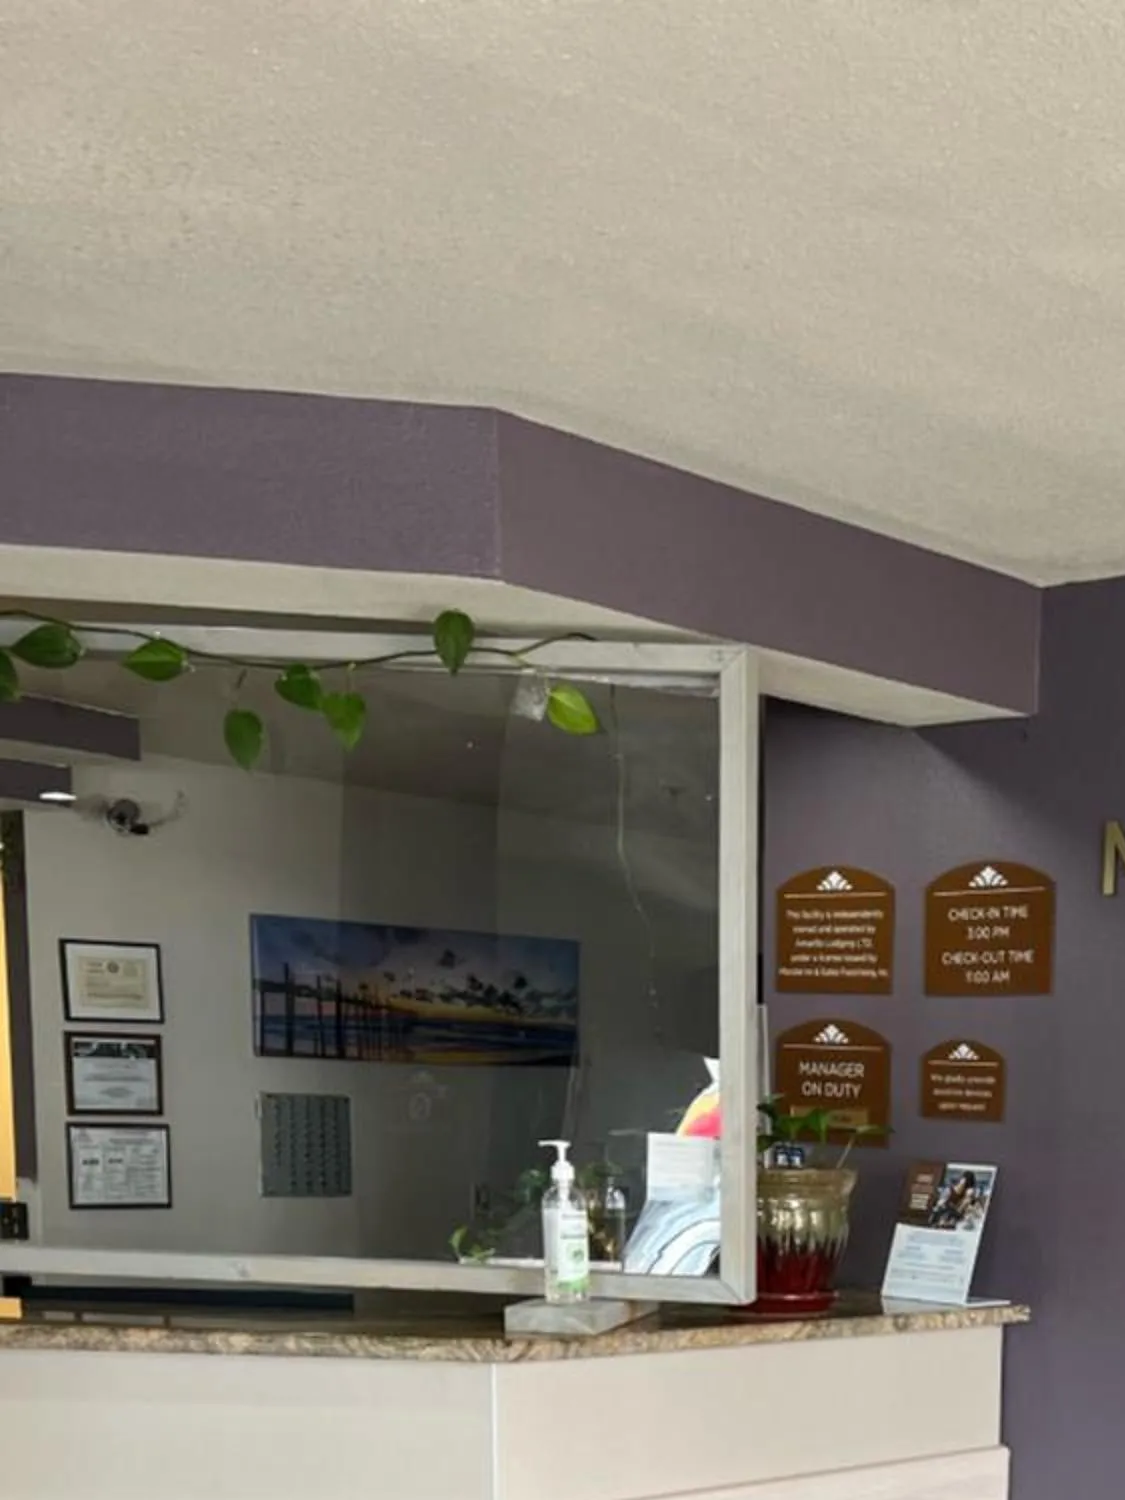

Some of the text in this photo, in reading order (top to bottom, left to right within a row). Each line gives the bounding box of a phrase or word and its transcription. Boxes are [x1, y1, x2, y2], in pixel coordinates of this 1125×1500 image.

[992, 969, 1010, 982] AM
[799, 1061, 865, 1078] MANAGER
[801, 1081, 862, 1098] ON DUTY
